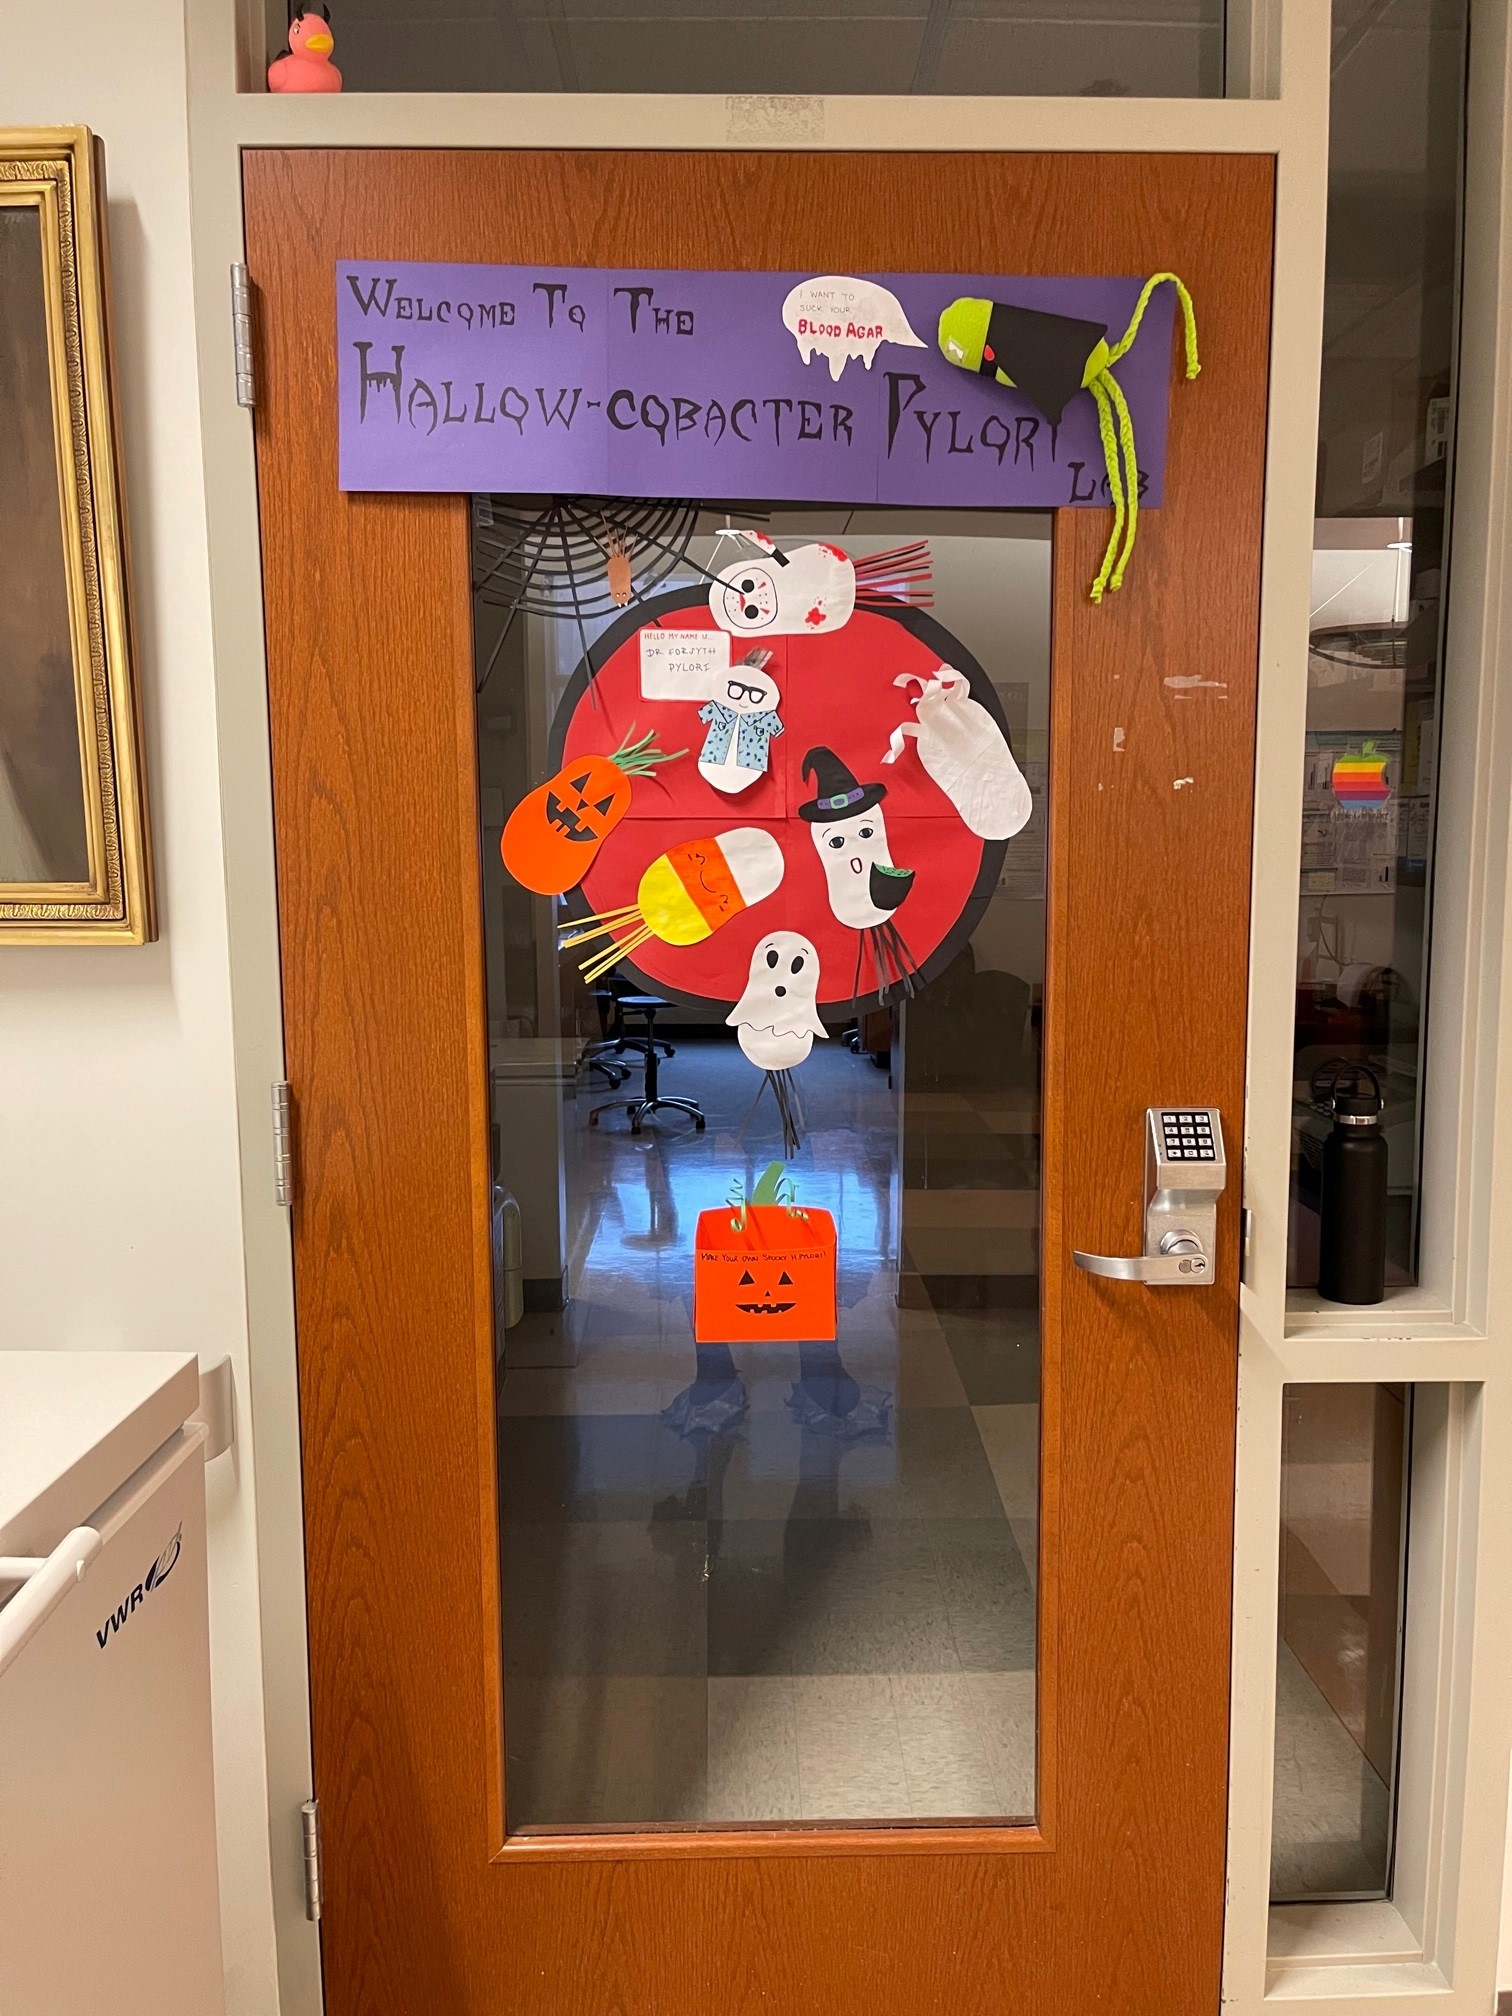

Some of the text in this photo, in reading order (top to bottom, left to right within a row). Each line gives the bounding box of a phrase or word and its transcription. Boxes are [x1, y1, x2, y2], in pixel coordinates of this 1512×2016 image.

[810, 290, 836, 300] WANT
[842, 292, 855, 301] TO
[346, 275, 694, 336] WELCOME TO THE
[799, 303, 852, 314] SUCK YOUR
[798, 318, 883, 339] BLOOD AGAR
[644, 632, 666, 640] HELLO
[668, 632, 679, 640] MY
[668, 662, 712, 673] PYLORI
[96, 1583, 144, 1650] VWR
